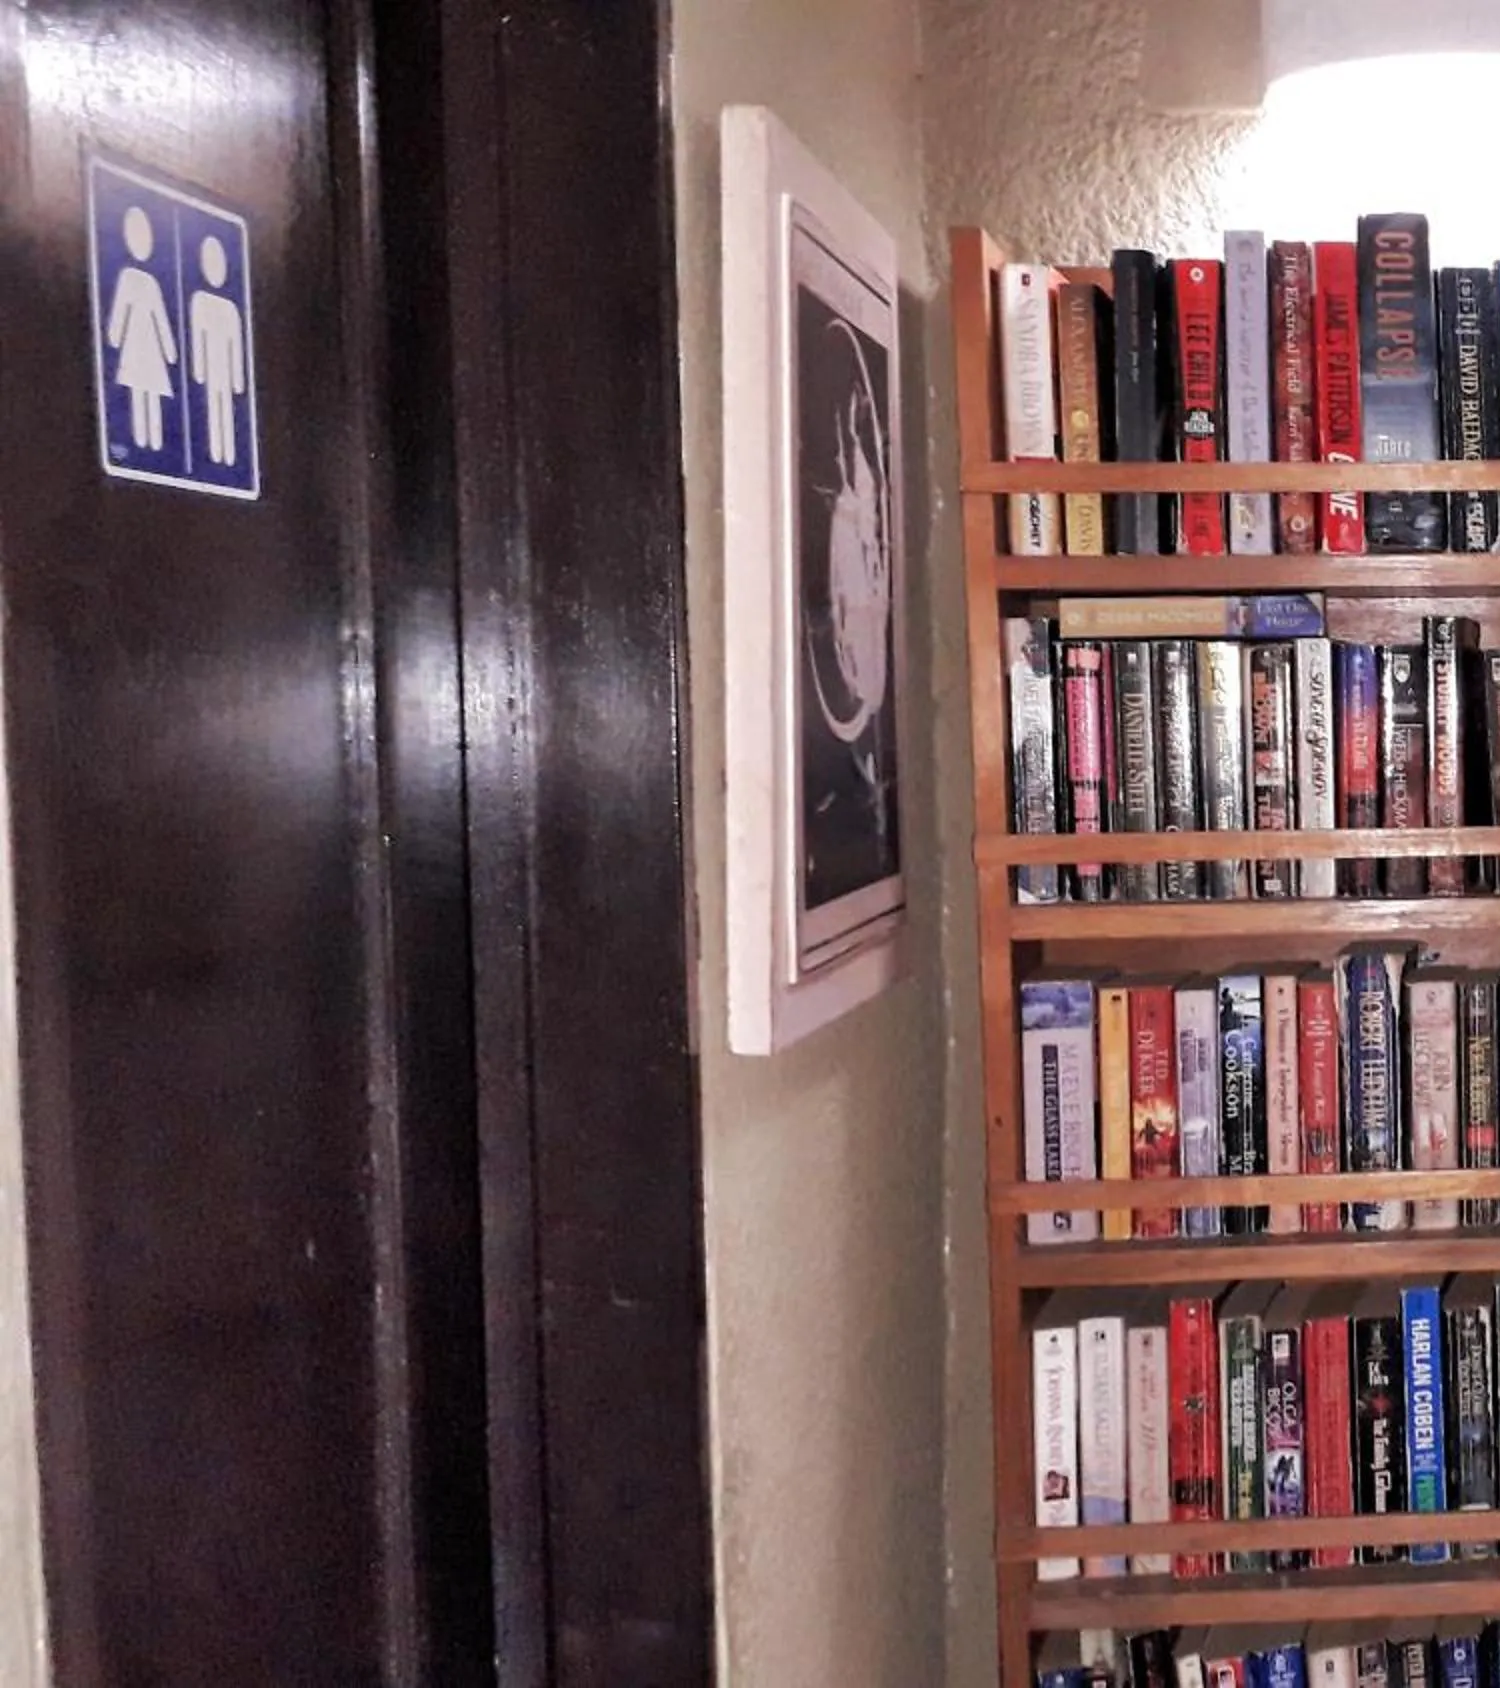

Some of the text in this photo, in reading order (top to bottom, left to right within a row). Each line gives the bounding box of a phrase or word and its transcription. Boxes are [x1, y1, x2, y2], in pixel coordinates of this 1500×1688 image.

[1284, 253, 1298, 282] The
[1374, 230, 1415, 381] COLLAPSE
[1187, 312, 1212, 400] LEE CHILD
[1285, 286, 1301, 353] Electrical
[1287, 359, 1301, 393] Field
[1326, 291, 1353, 445] JAMES PATTERSON
[1459, 344, 1482, 461] DAVID BALDAC
[1329, 452, 1359, 520] GNE
[1309, 671, 1325, 712] SONG
[1435, 663, 1459, 796] STUART WOODS
[1121, 692, 1150, 816] DANIELLE STEEL
[1395, 772, 1412, 829] HICKMA
[1155, 1047, 1169, 1079] TED
[1223, 1029, 1246, 1119] Cookson
[1240, 1038, 1257, 1109] Catherine
[1359, 990, 1387, 1129] ROBERT LUDLUM
[1042, 1060, 1062, 1178] THE GLASS LAKE
[1060, 1042, 1084, 1181] MAEVE BINCH
[1411, 1319, 1437, 1449] HARLAN COBEN
